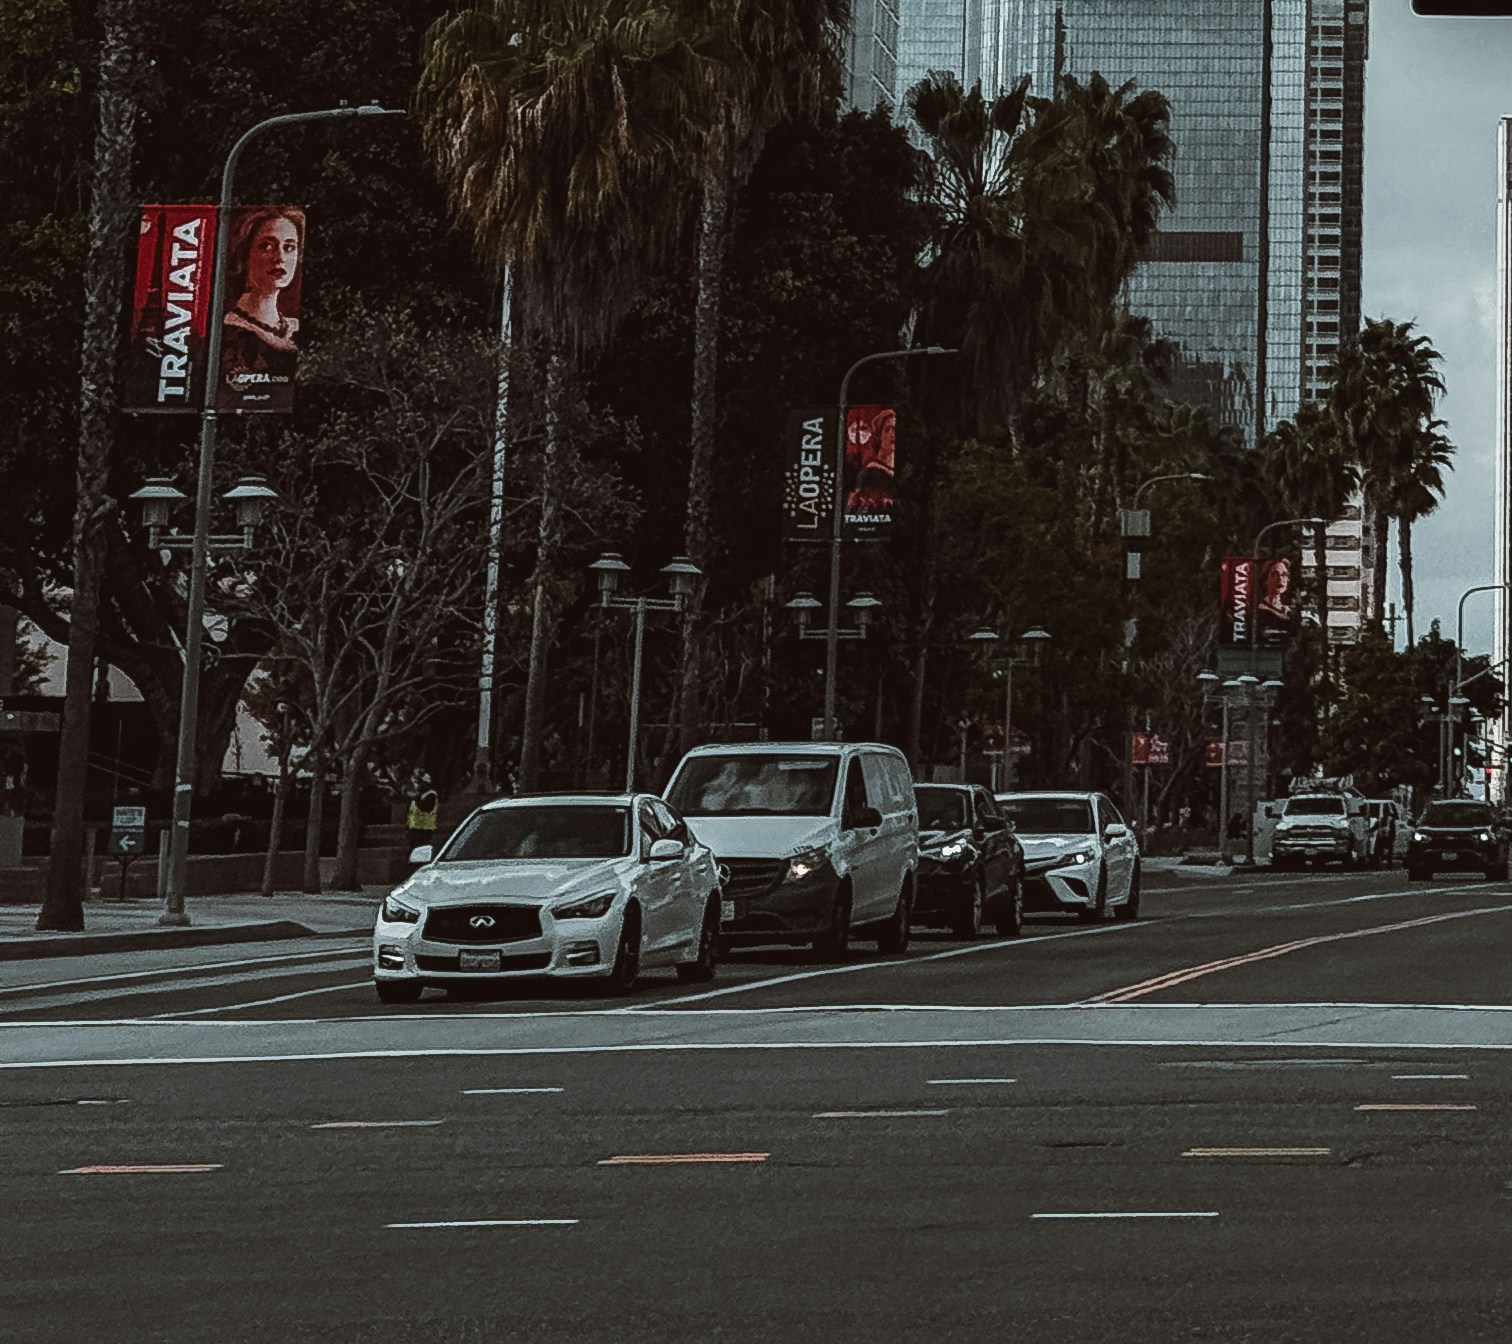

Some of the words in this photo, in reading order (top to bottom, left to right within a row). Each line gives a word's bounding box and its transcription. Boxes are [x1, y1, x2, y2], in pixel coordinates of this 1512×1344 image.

[157, 217, 203, 403] TRAVIATA
[844, 514, 892, 524] TRAVIATA
[1232, 562, 1250, 643] TRAVIATA
